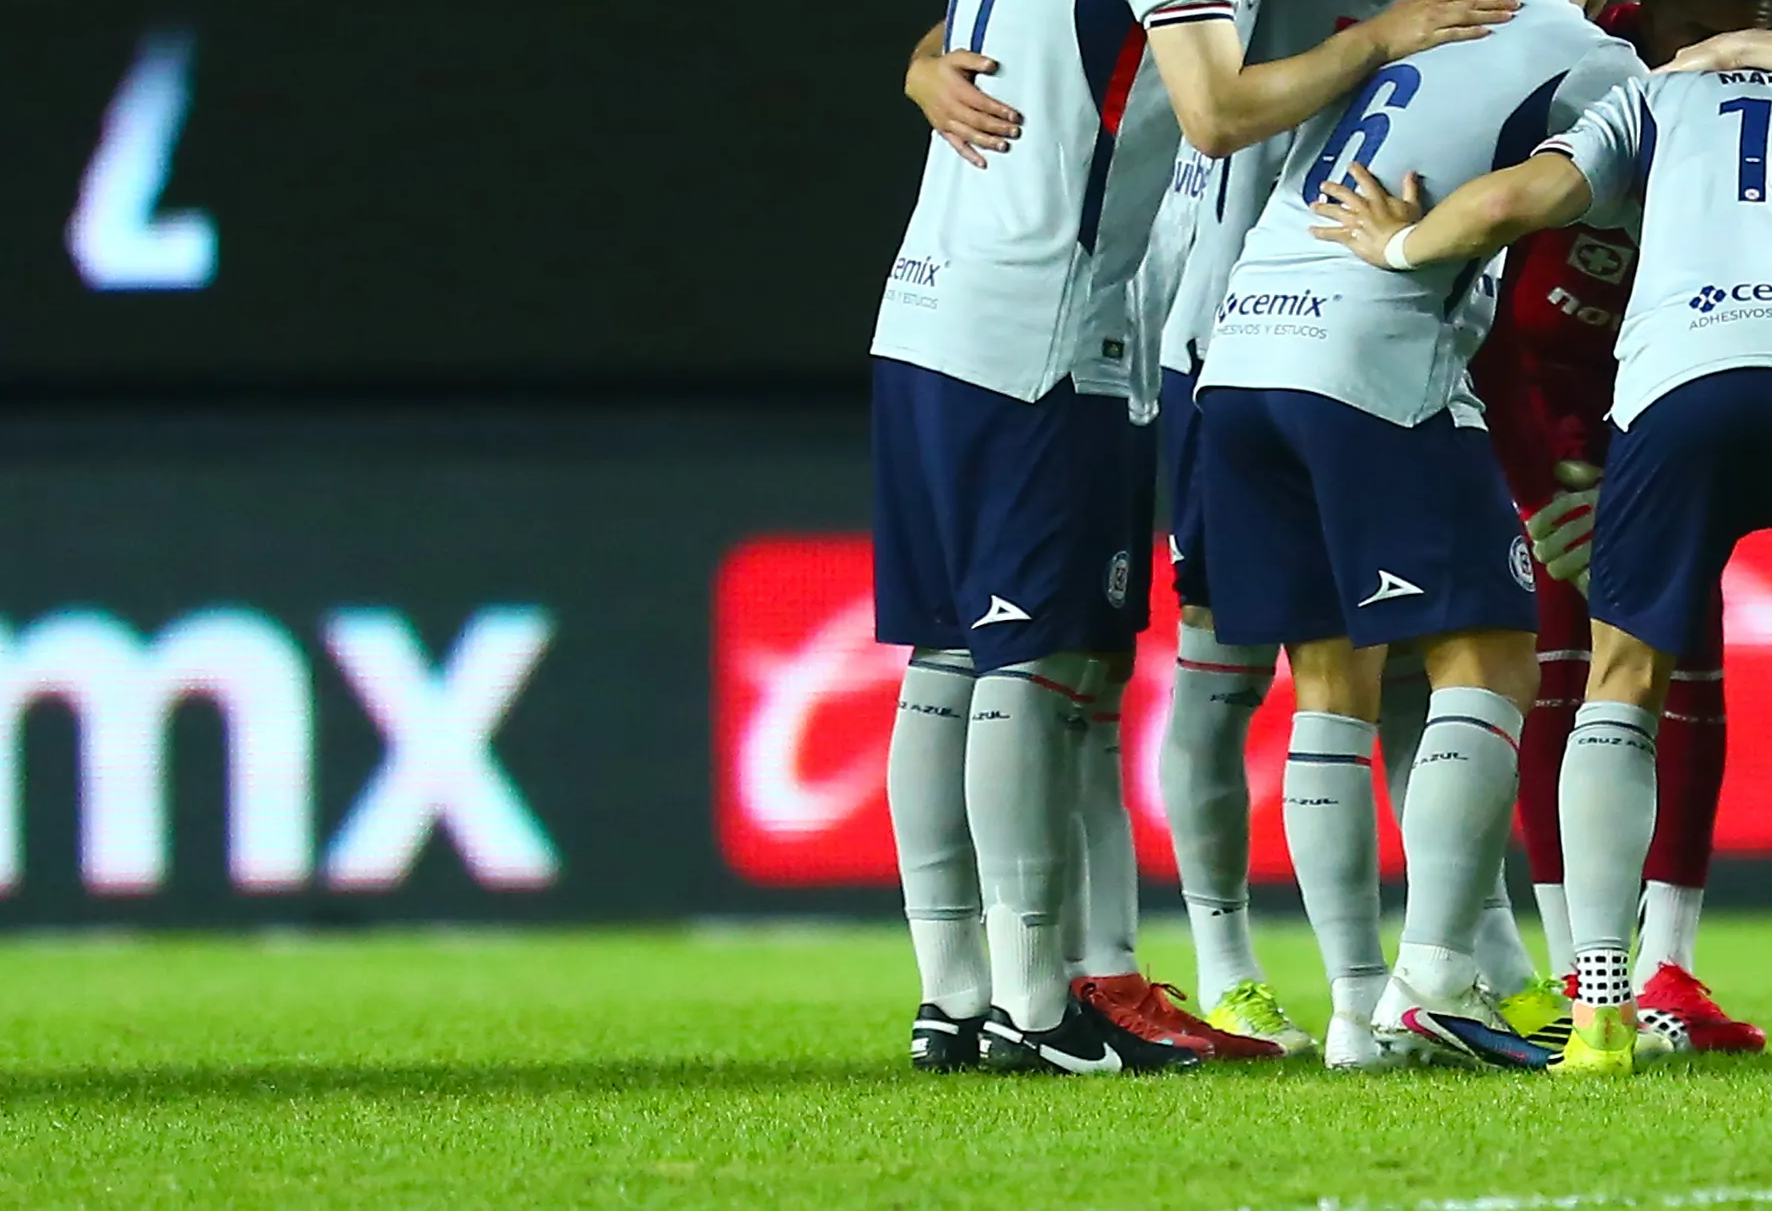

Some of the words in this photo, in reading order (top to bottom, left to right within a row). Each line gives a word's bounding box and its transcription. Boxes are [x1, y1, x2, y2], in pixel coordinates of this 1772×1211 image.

[1302, 63, 1422, 206] 6
[889, 255, 940, 287] emix
[1239, 289, 1327, 317] cemix
[1578, 737, 1621, 745] CRUZ
